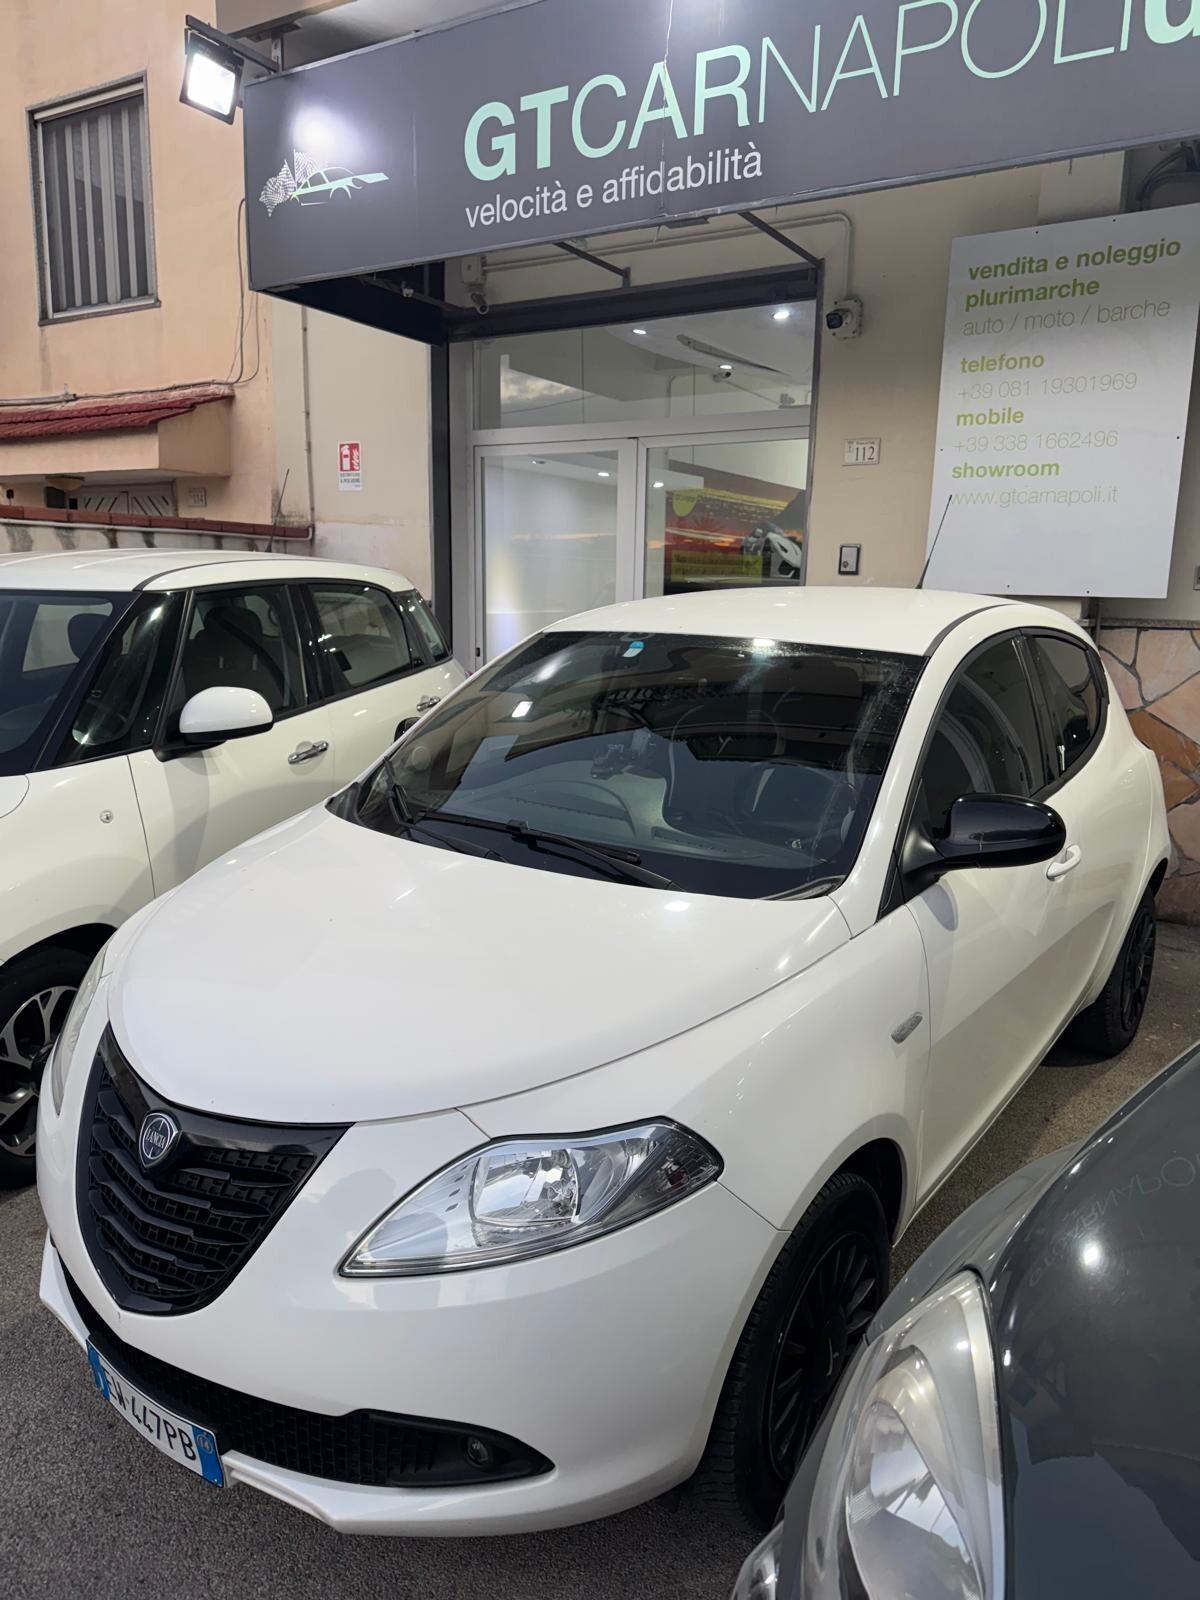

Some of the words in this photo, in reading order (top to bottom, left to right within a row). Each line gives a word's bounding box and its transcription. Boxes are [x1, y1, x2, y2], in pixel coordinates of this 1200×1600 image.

[465, 180, 567, 228] velocità
[576, 185, 592, 209] e
[602, 141, 763, 203] affidabilità
[968, 255, 1048, 281] vendita
[1055, 255, 1069, 271] e
[1076, 237, 1181, 268] noleggio
[965, 278, 1100, 313] plurimarche
[963, 317, 1004, 337] auto
[1024, 309, 1075, 331] moto
[1097, 296, 1170, 324] barche
[960, 353, 1045, 374] telefono
[957, 382, 993, 401] +39
[998, 379, 1031, 398] 081
[1041, 371, 1138, 395] 19301969
[956, 407, 1025, 427] mobile
[855, 445, 875, 461] 112
[953, 436, 989, 453] +39
[993, 434, 1028, 451] 338
[1035, 430, 1119, 450] 1662496
[951, 462, 1060, 479] showroom
